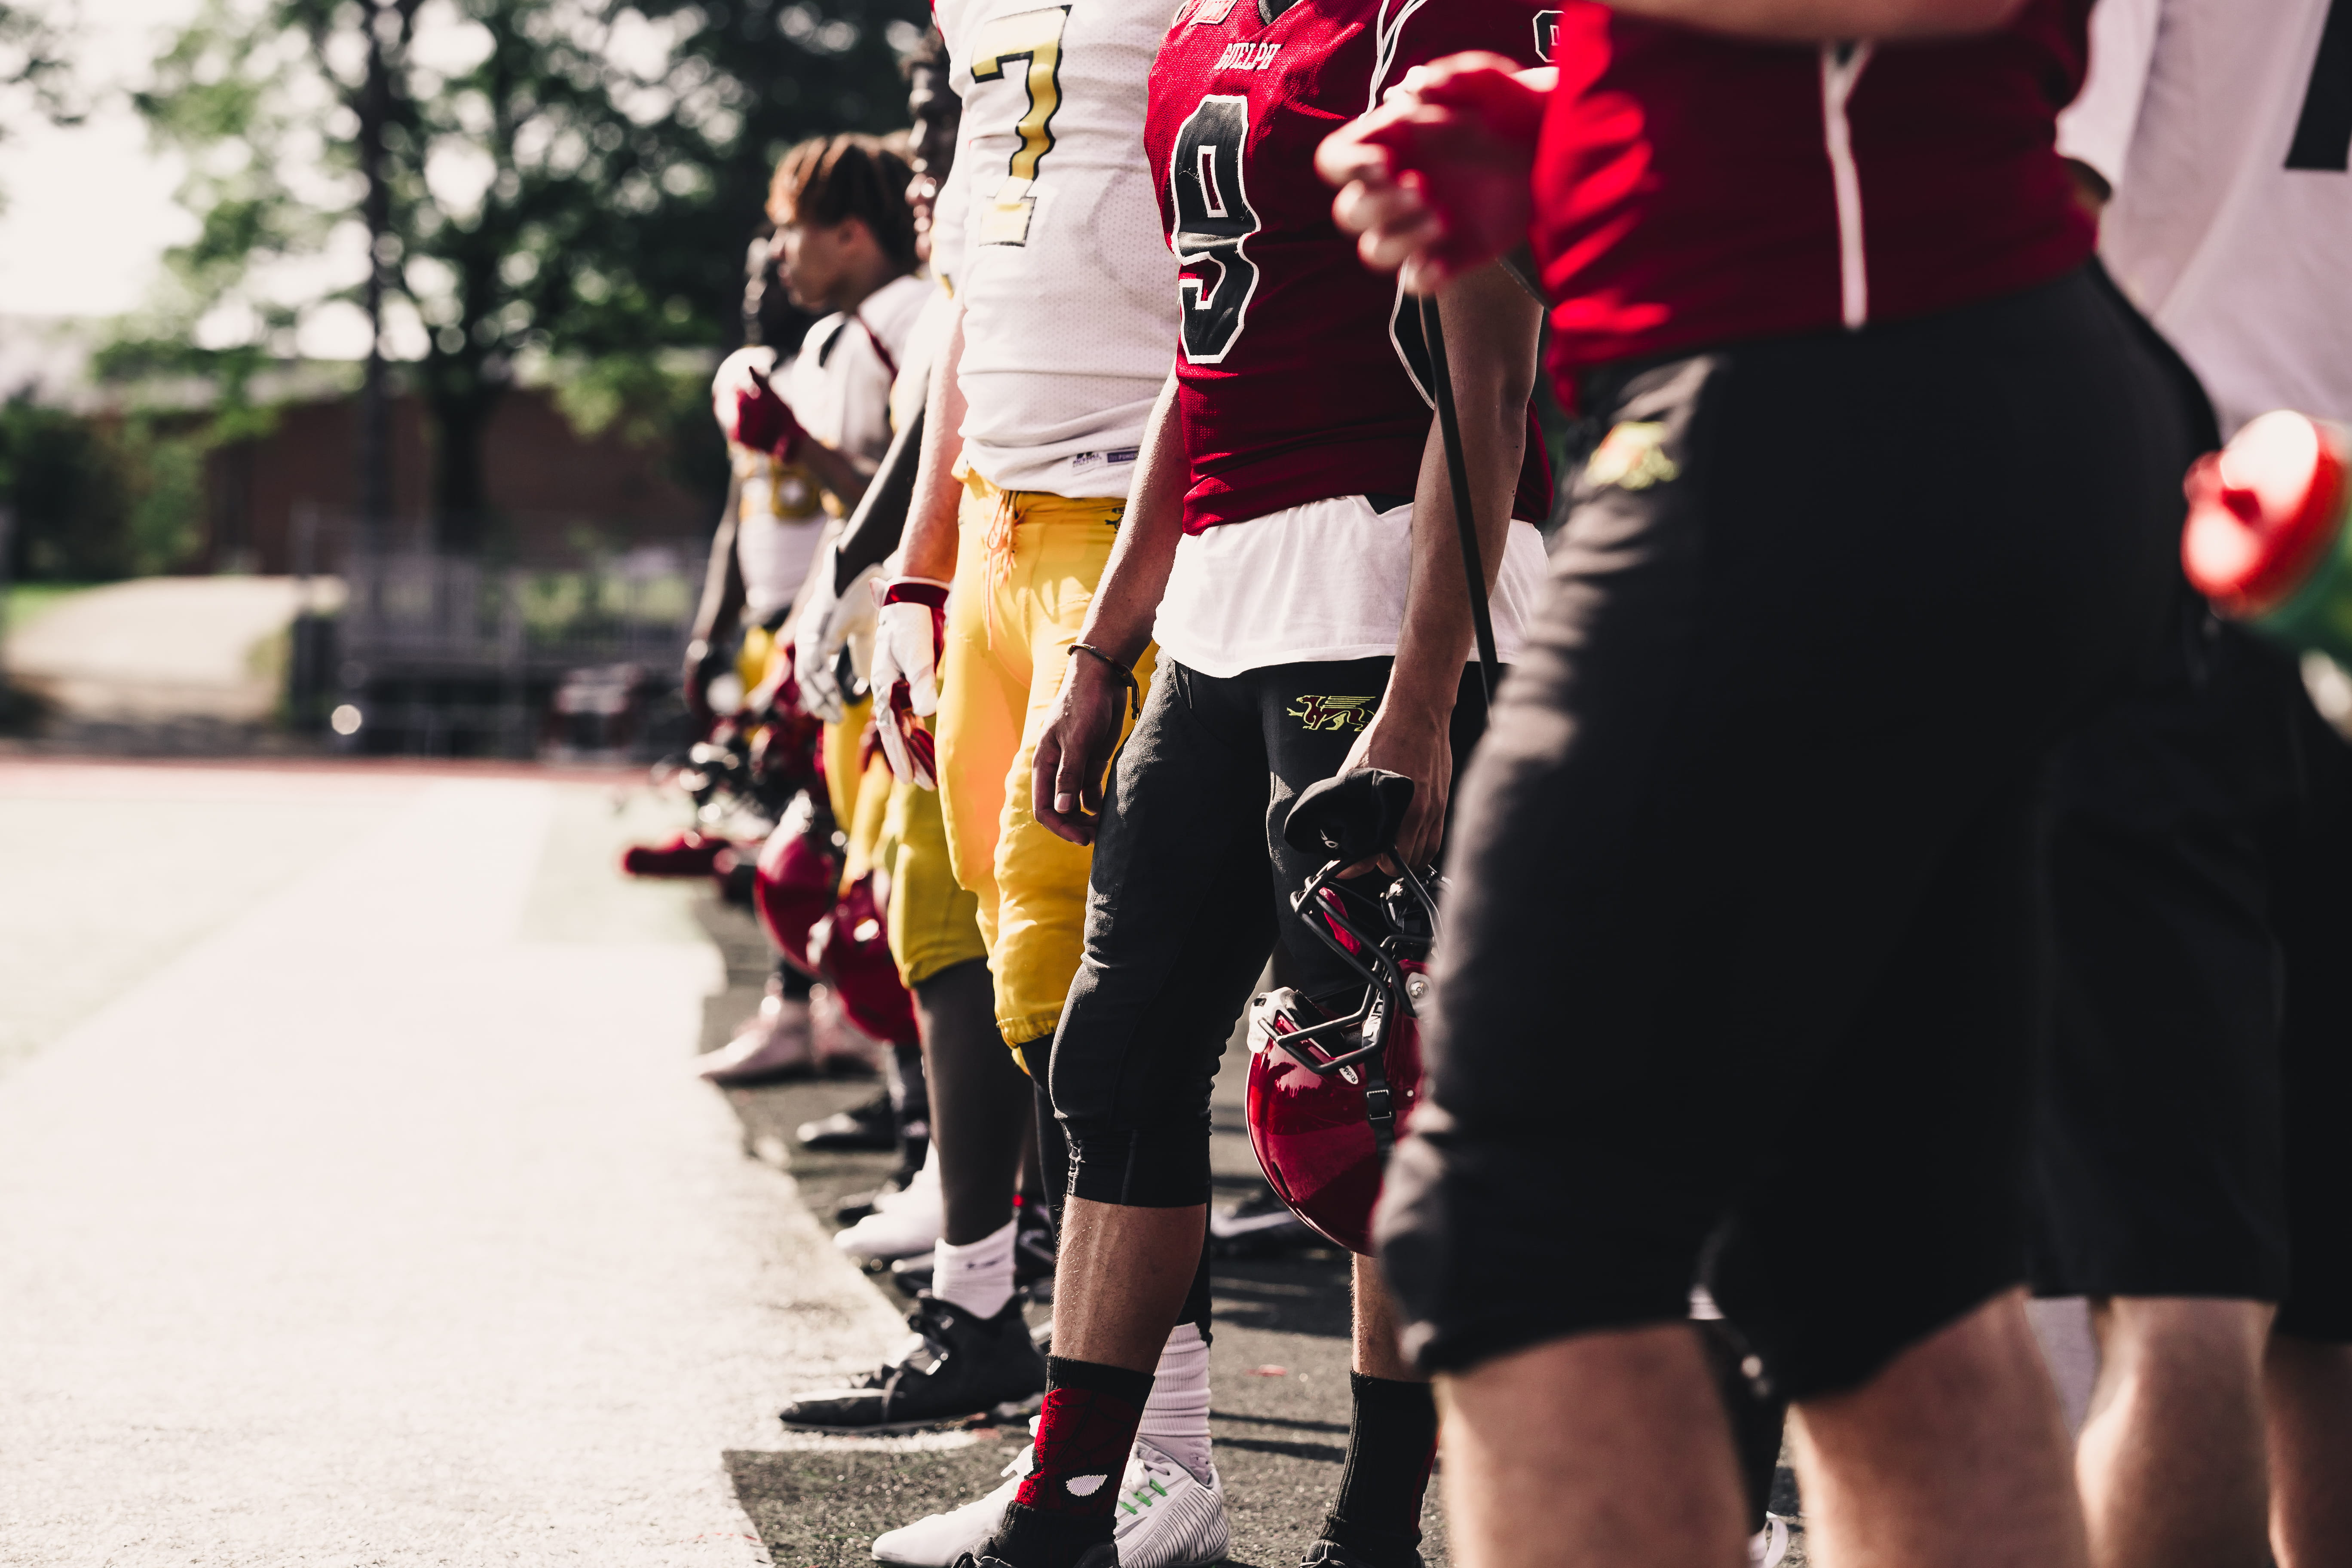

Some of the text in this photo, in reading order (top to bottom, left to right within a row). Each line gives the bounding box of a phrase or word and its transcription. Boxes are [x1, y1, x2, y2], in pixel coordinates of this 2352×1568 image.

[970, 4, 1073, 248] 7
[1213, 42, 1282, 70] GUELPH
[1170, 94, 1262, 364] 9
